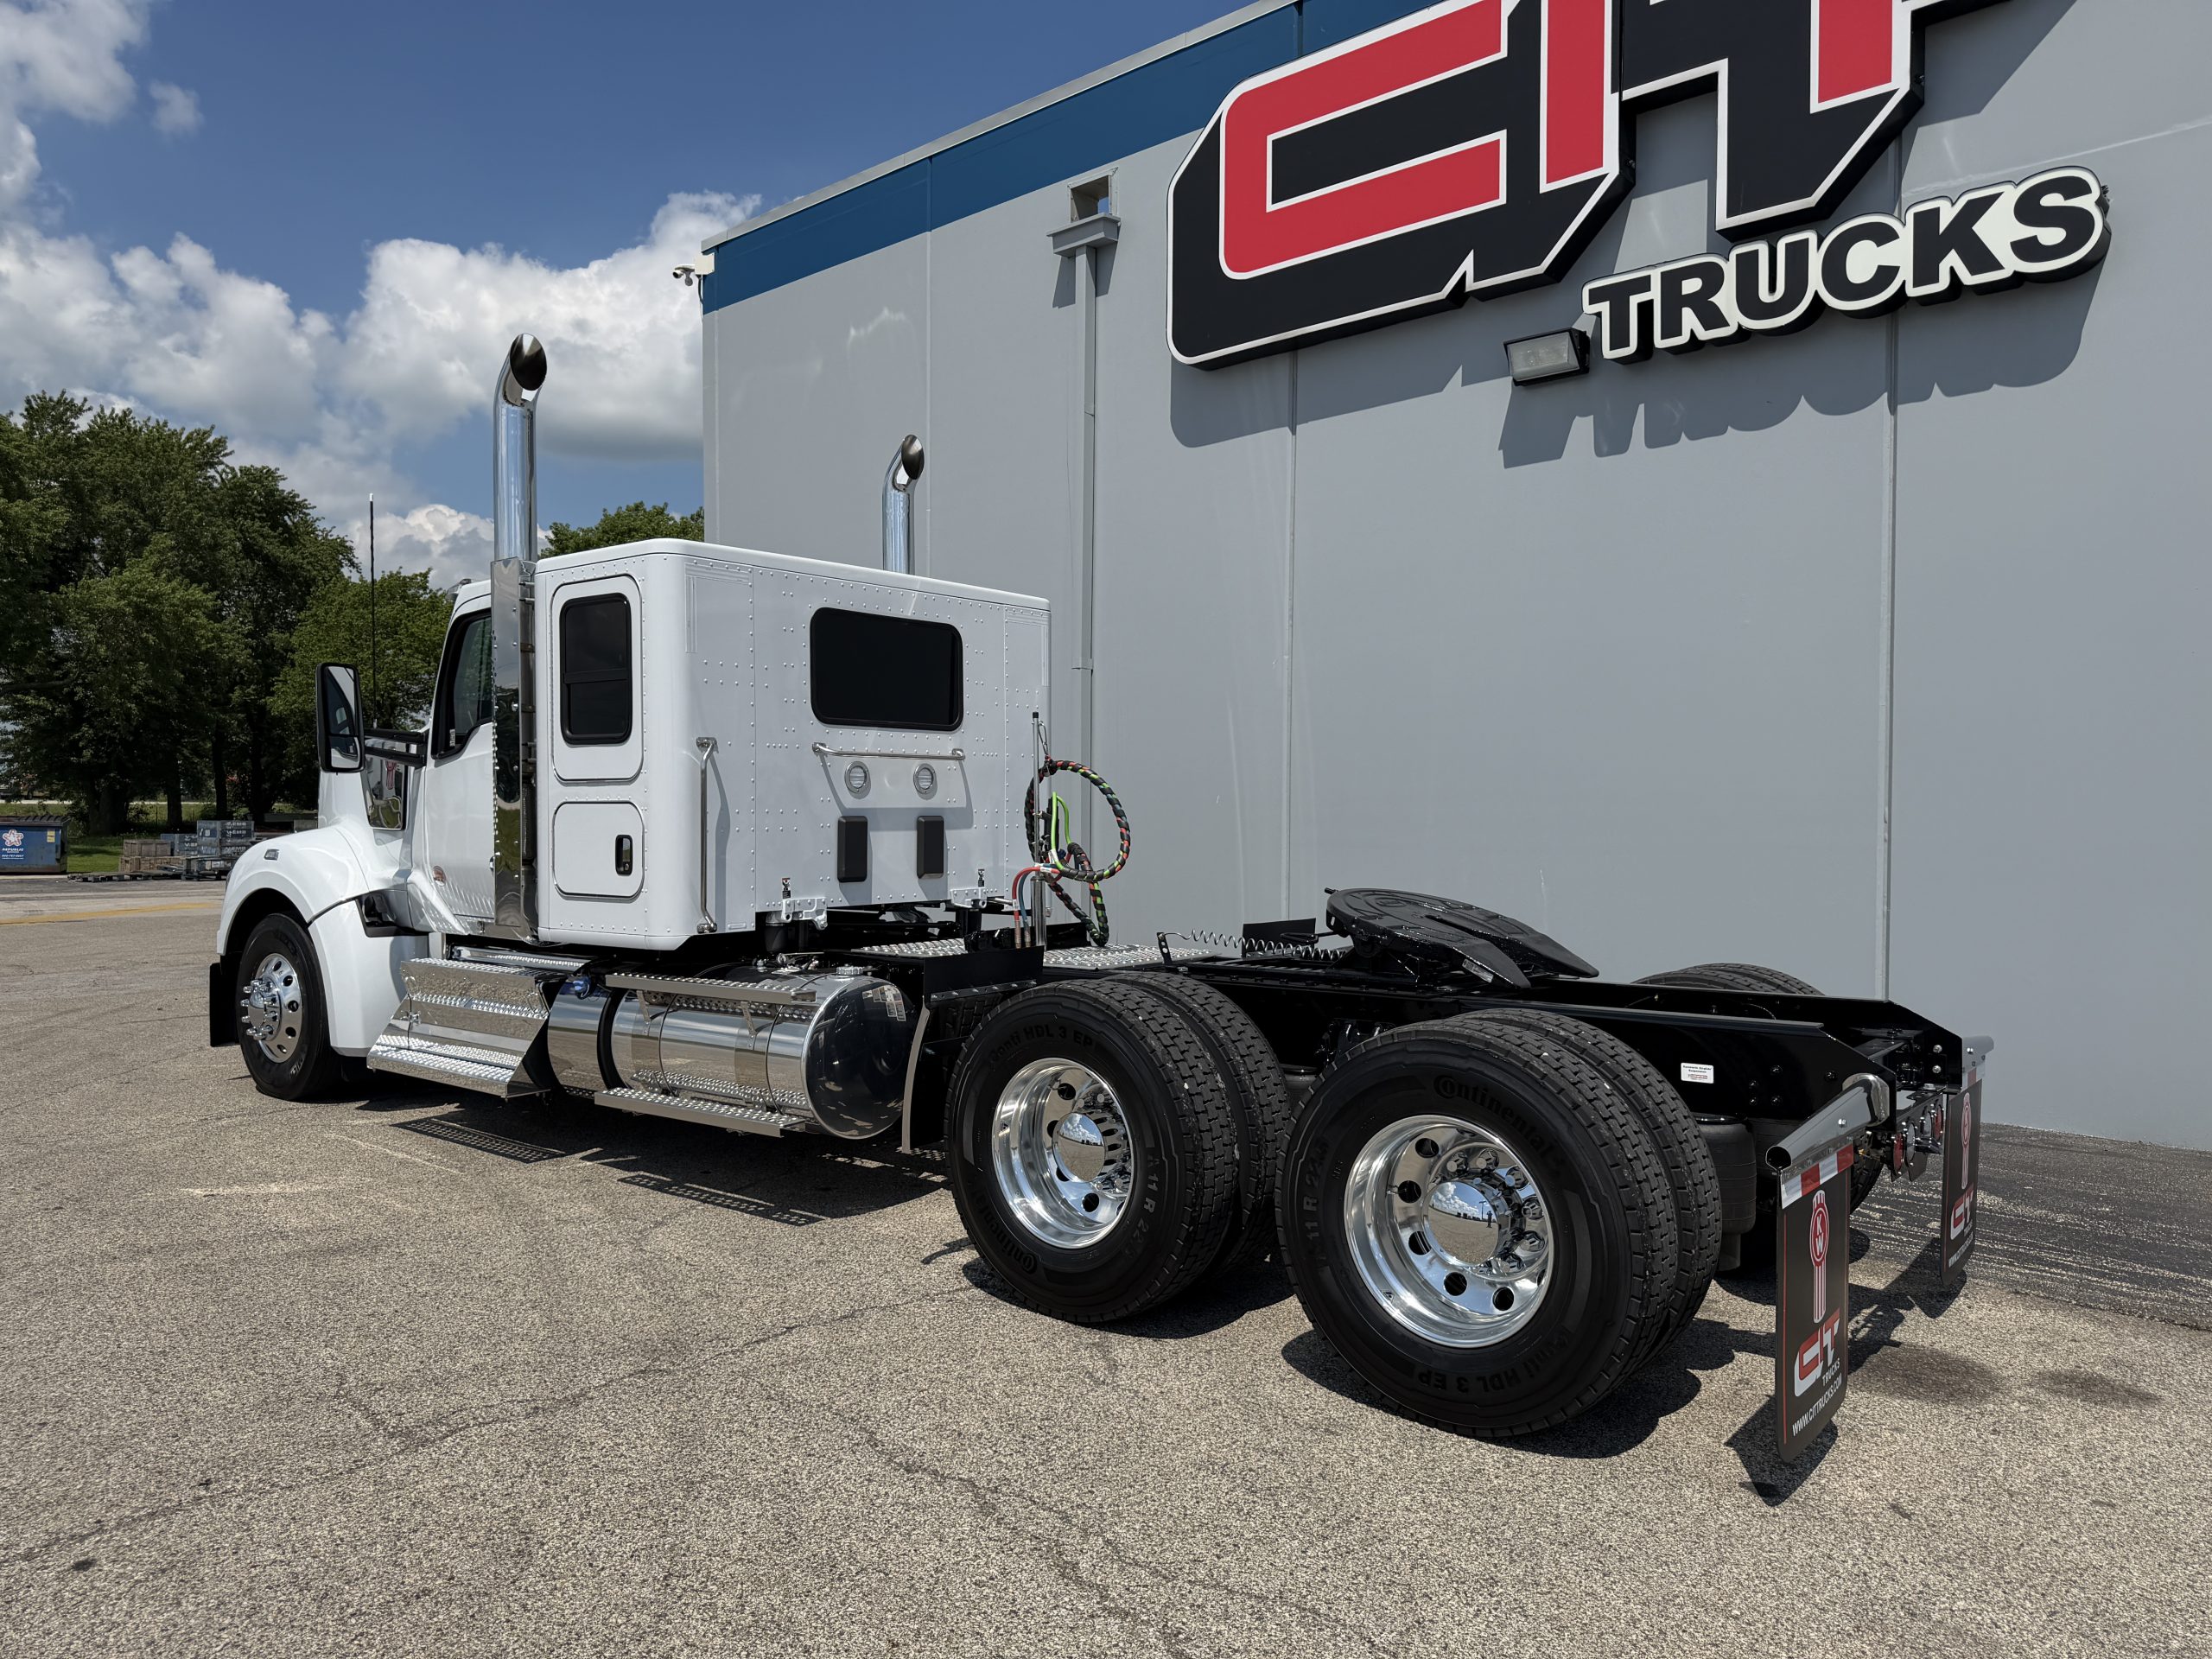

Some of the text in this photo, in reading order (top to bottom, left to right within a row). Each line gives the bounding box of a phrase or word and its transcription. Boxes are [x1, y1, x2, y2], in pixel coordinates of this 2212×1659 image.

[1586, 173, 2096, 354] TRUCKS
[1023, 1024, 1054, 1040] HDL
[1058, 1026, 1068, 1039] 3
[1073, 1029, 1094, 1047] EP
[1433, 1074, 1555, 1160] Continental
[1143, 1197, 1156, 1213] R
[1303, 1195, 1319, 1211] R
[1795, 1306, 1840, 1397] CIT
[1418, 1370, 1447, 1390] EP
[1456, 1376, 1470, 1393] 3
[1477, 1368, 1522, 1393] HDL
[1821, 1357, 1840, 1387] TRUCKS
[1792, 1372, 1842, 1437] WWW.CITTRUCKS.COM
